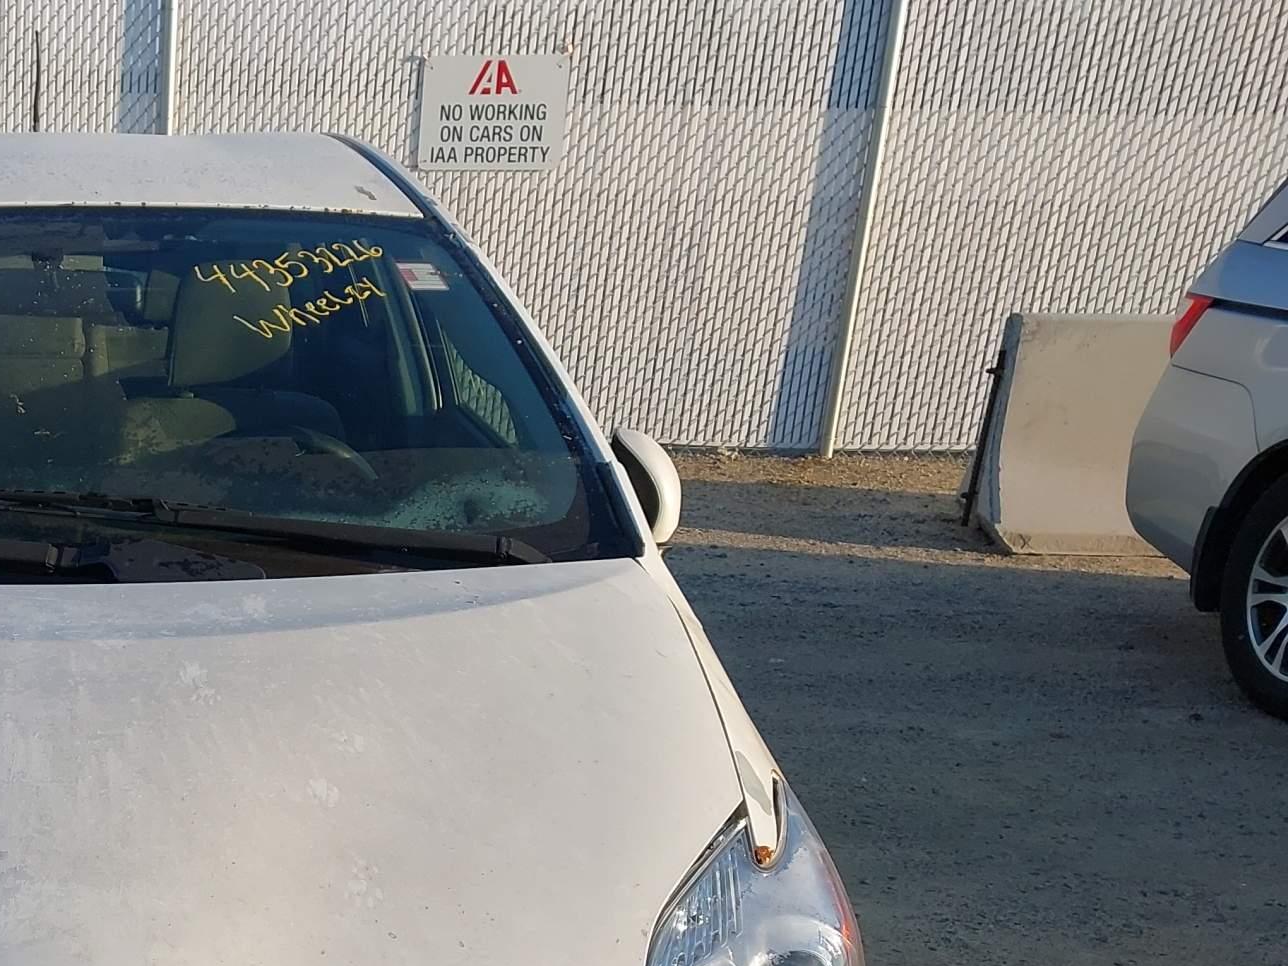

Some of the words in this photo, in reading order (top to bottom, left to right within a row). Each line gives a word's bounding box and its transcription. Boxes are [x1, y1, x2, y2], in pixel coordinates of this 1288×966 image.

[440, 104, 462, 121] NO
[469, 103, 547, 121] WORKING
[440, 125, 462, 142] ON
[470, 125, 513, 142] CARS
[520, 125, 543, 142] ON
[430, 147, 457, 163] IAA
[463, 146, 550, 163] PROPERTY
